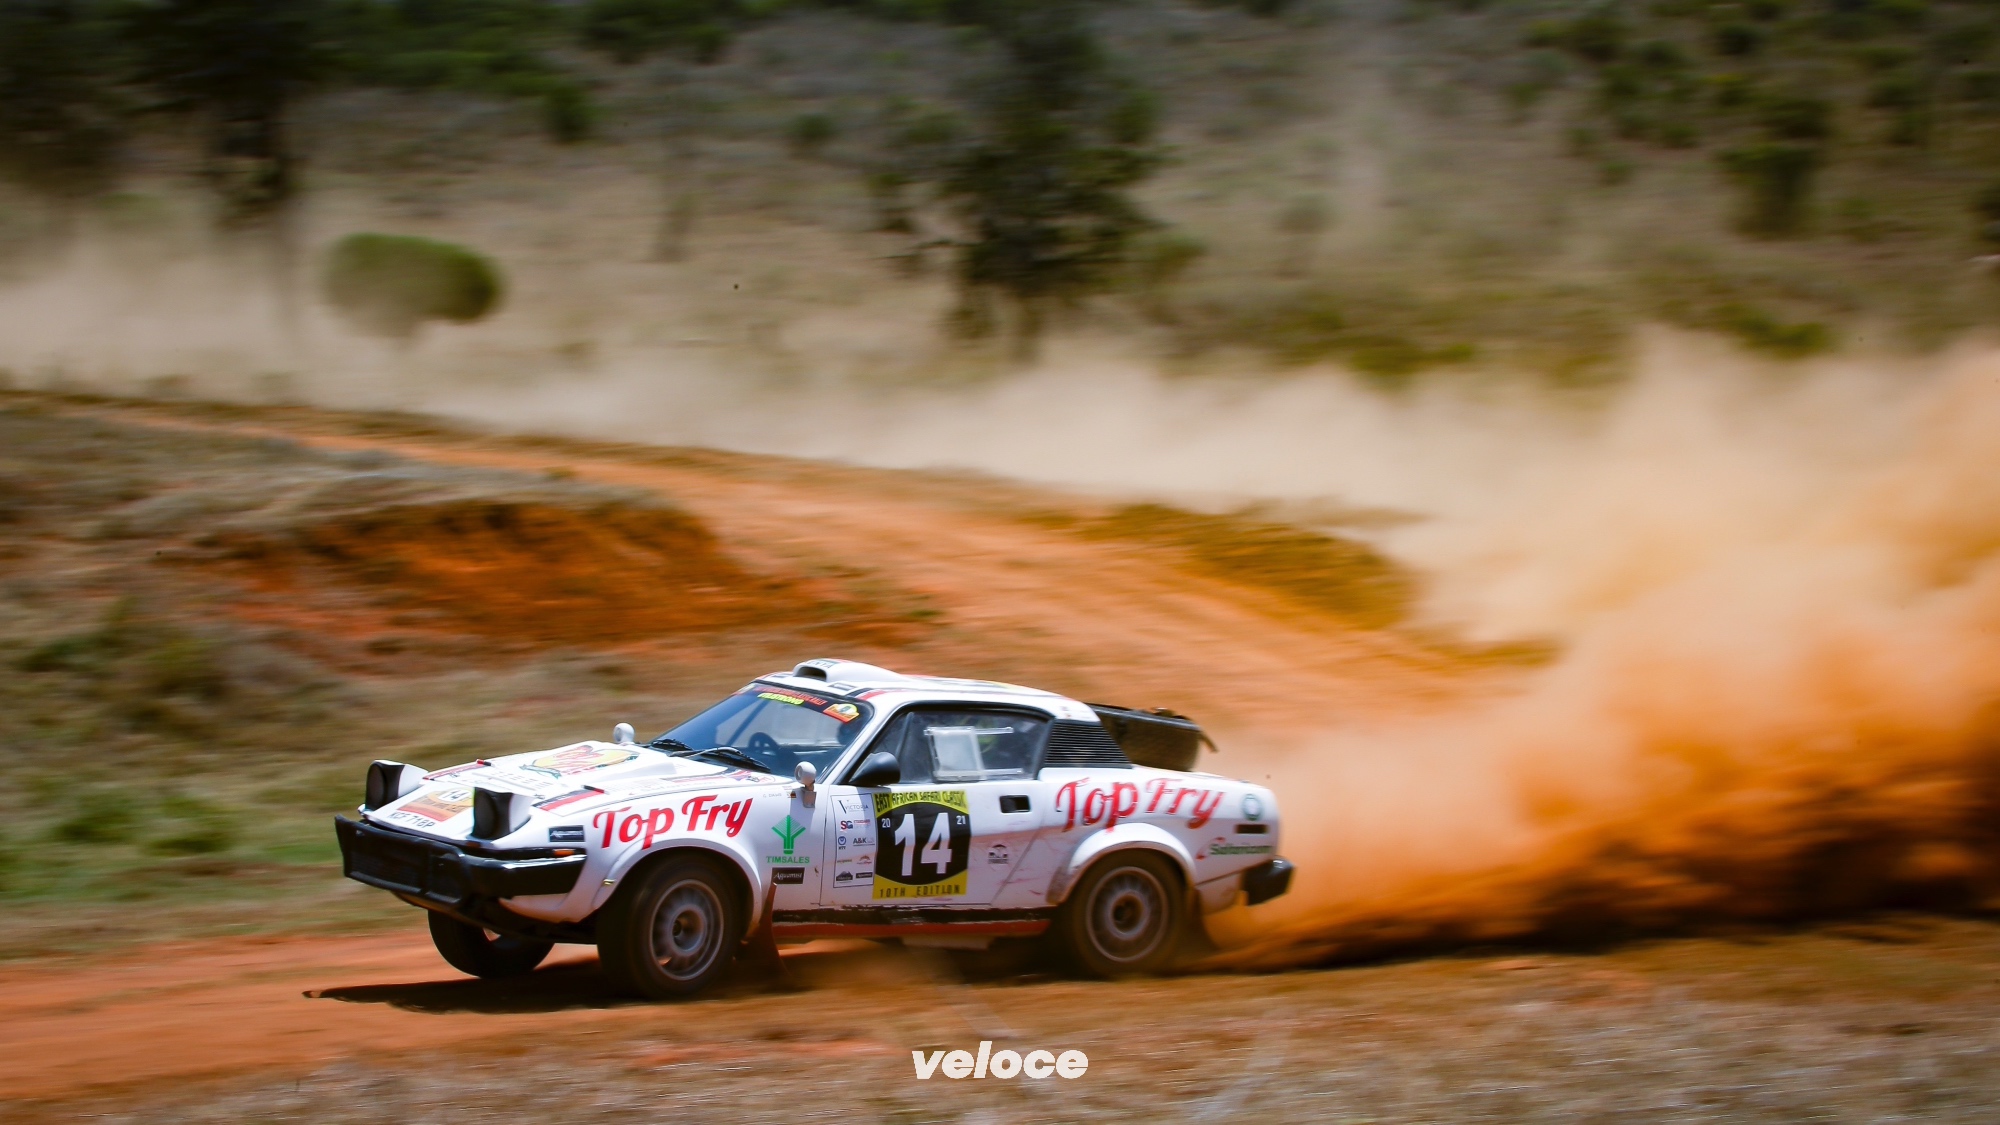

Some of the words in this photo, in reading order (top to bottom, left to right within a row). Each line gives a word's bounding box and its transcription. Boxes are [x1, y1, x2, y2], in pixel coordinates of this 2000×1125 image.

[442, 789, 469, 800] 14
[874, 793, 890, 812] EAST
[891, 792, 918, 805] AFRICAN
[919, 791, 940, 802] SAFARI
[942, 790, 966, 808] CLASSIC
[1055, 778, 1140, 833] Top
[1145, 777, 1226, 830] Fry
[593, 806, 675, 850] Top
[681, 794, 754, 838] Fry
[881, 817, 891, 828] 20
[956, 815, 966, 825] 21
[894, 812, 953, 877] 14
[766, 856, 810, 864] TIMSALES
[880, 887, 906, 898] 10TH
[916, 884, 960, 896] EDITION
